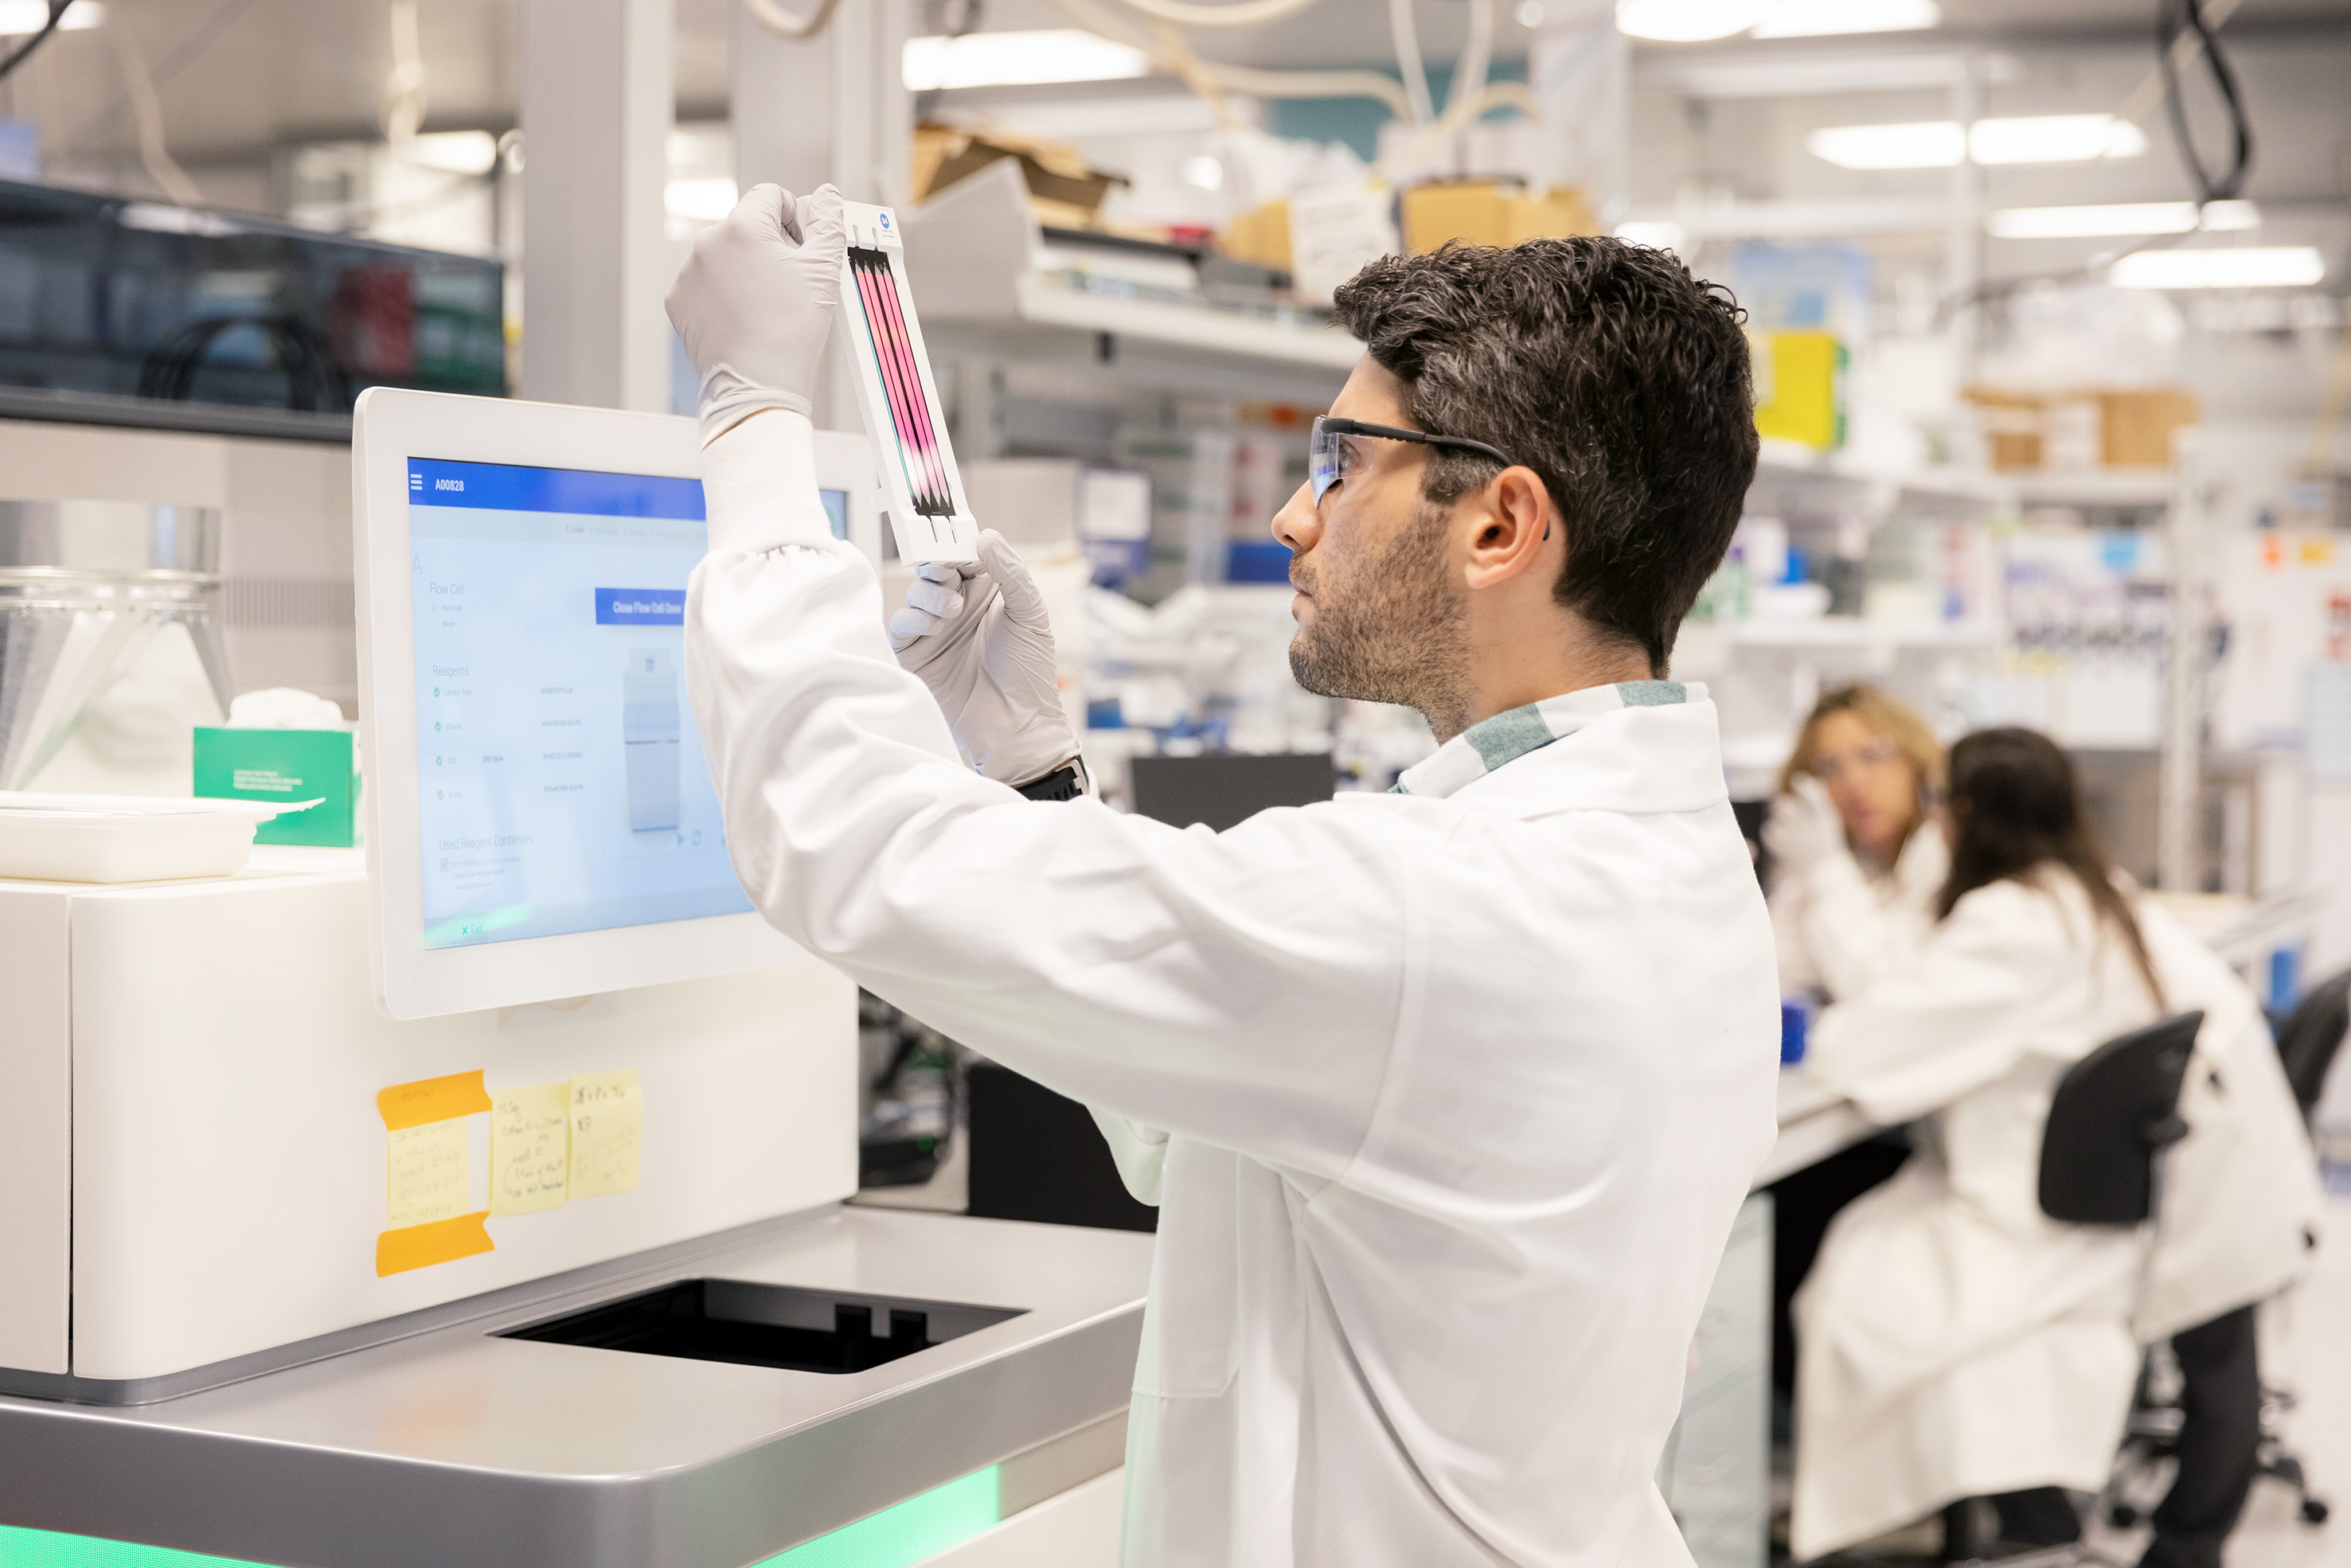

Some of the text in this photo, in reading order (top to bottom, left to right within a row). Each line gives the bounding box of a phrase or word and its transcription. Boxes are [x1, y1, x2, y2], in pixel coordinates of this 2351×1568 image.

[435, 478, 464, 492] A00828
[429, 582, 465, 595] Flow Cell
[613, 600, 682, 615] Close Flow Cell Door
[432, 664, 470, 680] Reagents
[445, 688, 473, 698] Library Tube
[491, 755, 504, 765] Cycle
[439, 834, 533, 851] Used Reagent Containers
[471, 924, 483, 934] Exit
